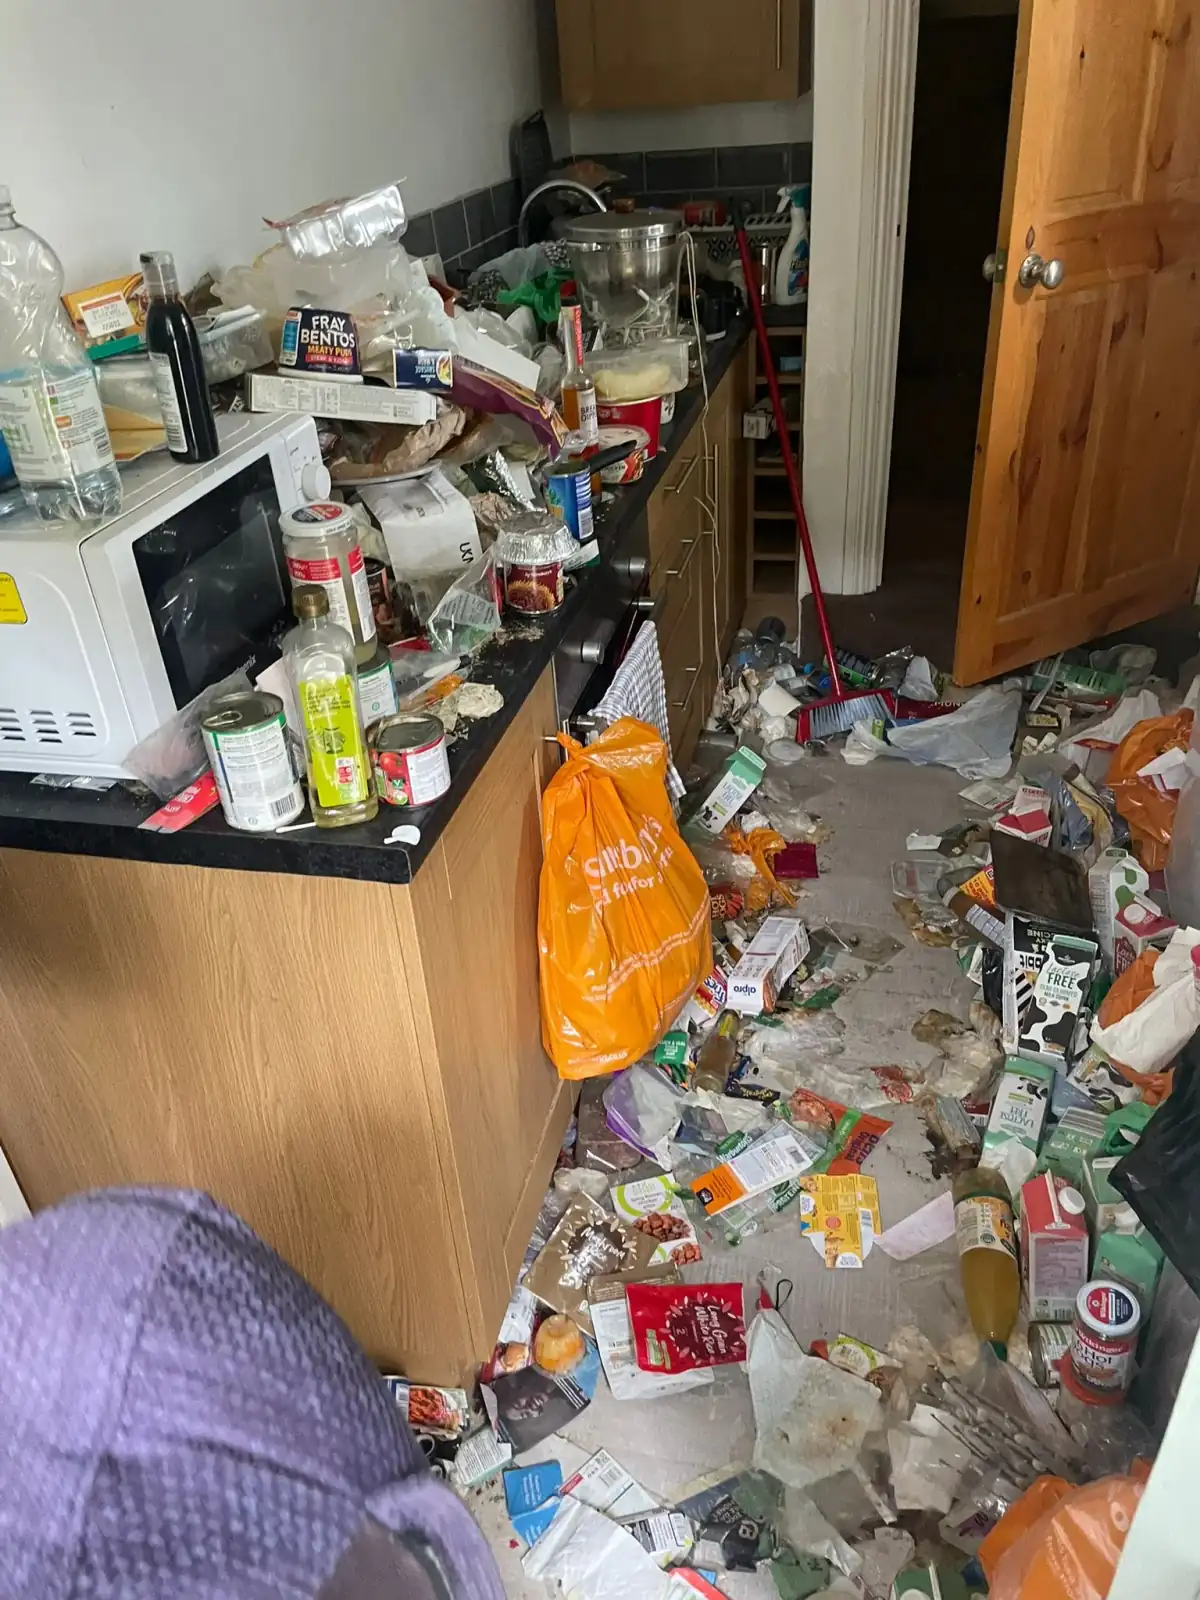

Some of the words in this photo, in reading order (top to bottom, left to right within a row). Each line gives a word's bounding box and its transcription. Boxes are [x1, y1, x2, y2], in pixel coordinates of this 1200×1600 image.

[312, 315, 346, 333] FRAY
[301, 329, 355, 348] BENTOS
[307, 345, 334, 356] MEATY
[733, 984, 757, 996] alpro
[1048, 972, 1076, 990] FREE
[694, 1306, 710, 1336] White
[708, 1305, 720, 1328] Long
[701, 1336, 715, 1354] Rice
[712, 1329, 728, 1354] Grain
